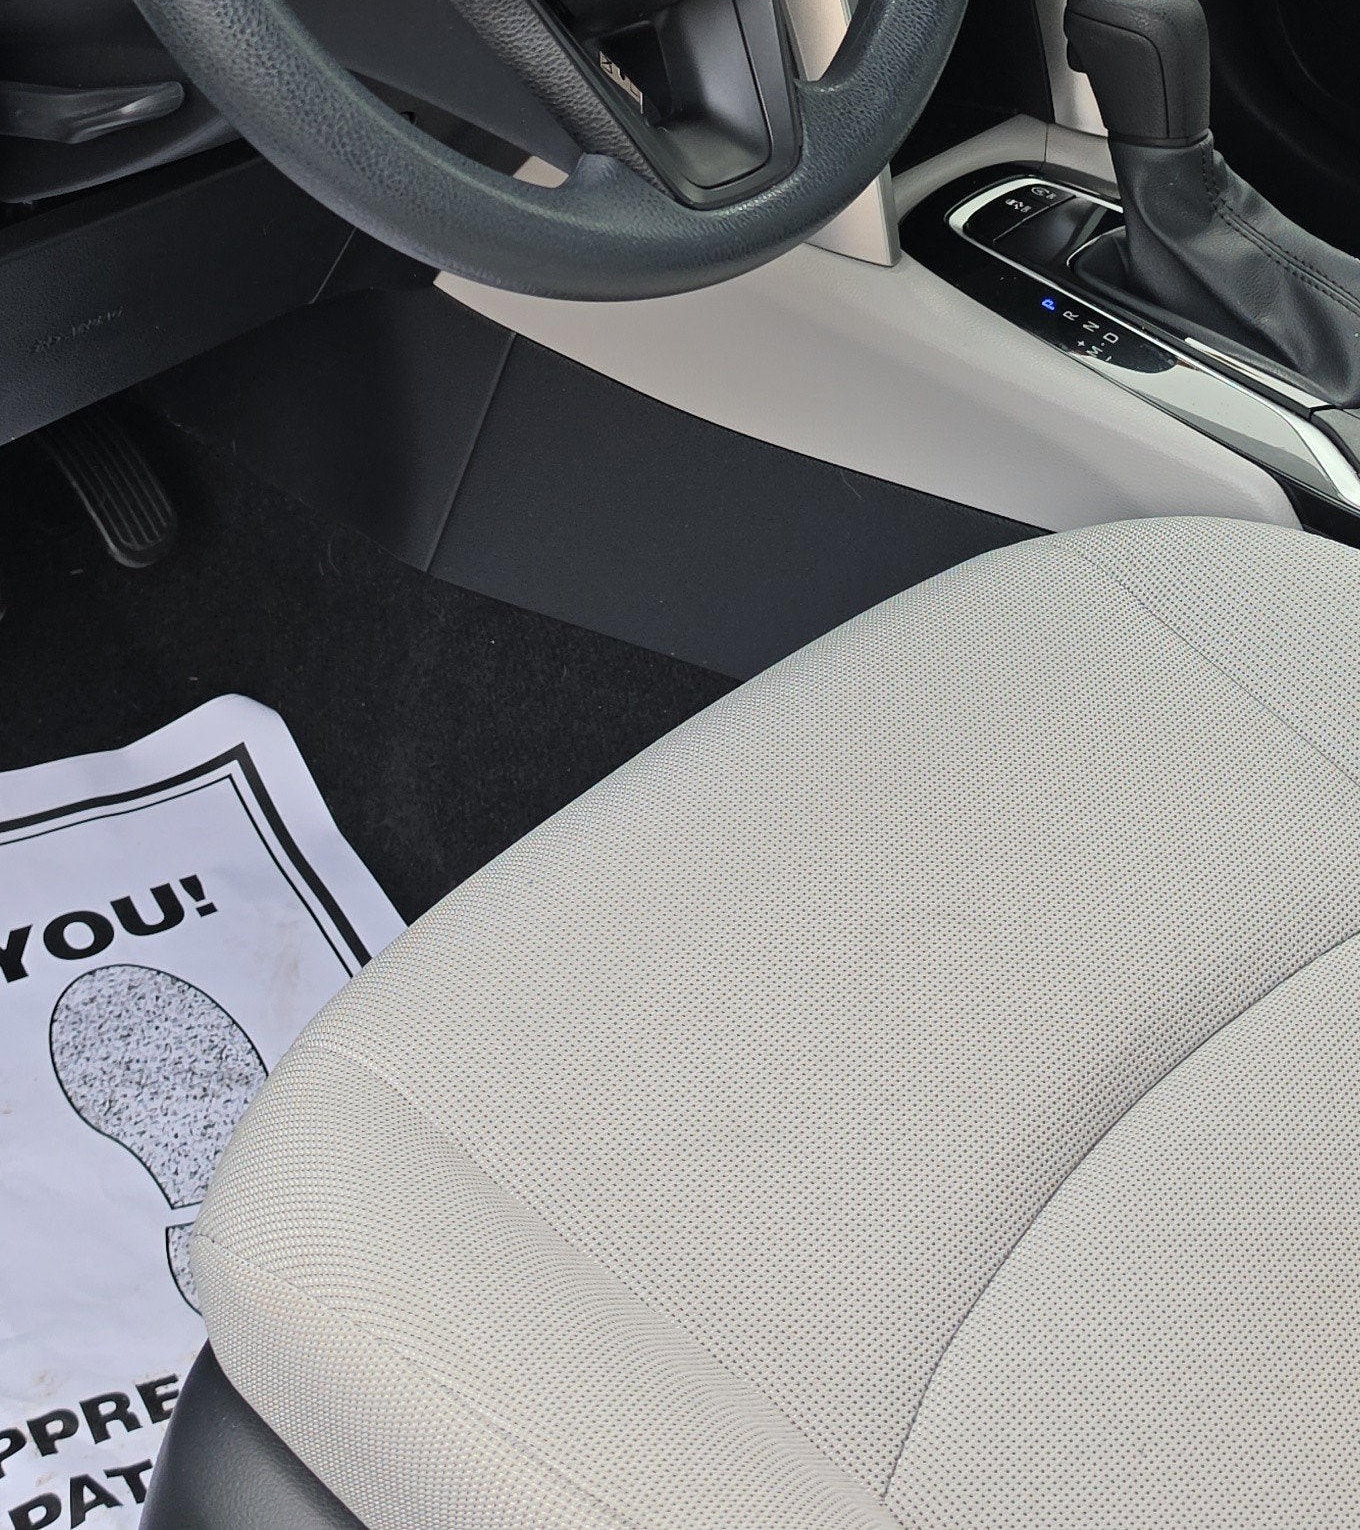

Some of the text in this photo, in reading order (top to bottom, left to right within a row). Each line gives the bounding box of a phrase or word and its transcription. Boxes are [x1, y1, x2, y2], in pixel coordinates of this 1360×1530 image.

[1041, 298, 1120, 344] P R N D
[1085, 345, 1103, 358] M
[7, 1458, 154, 1530] PAT
